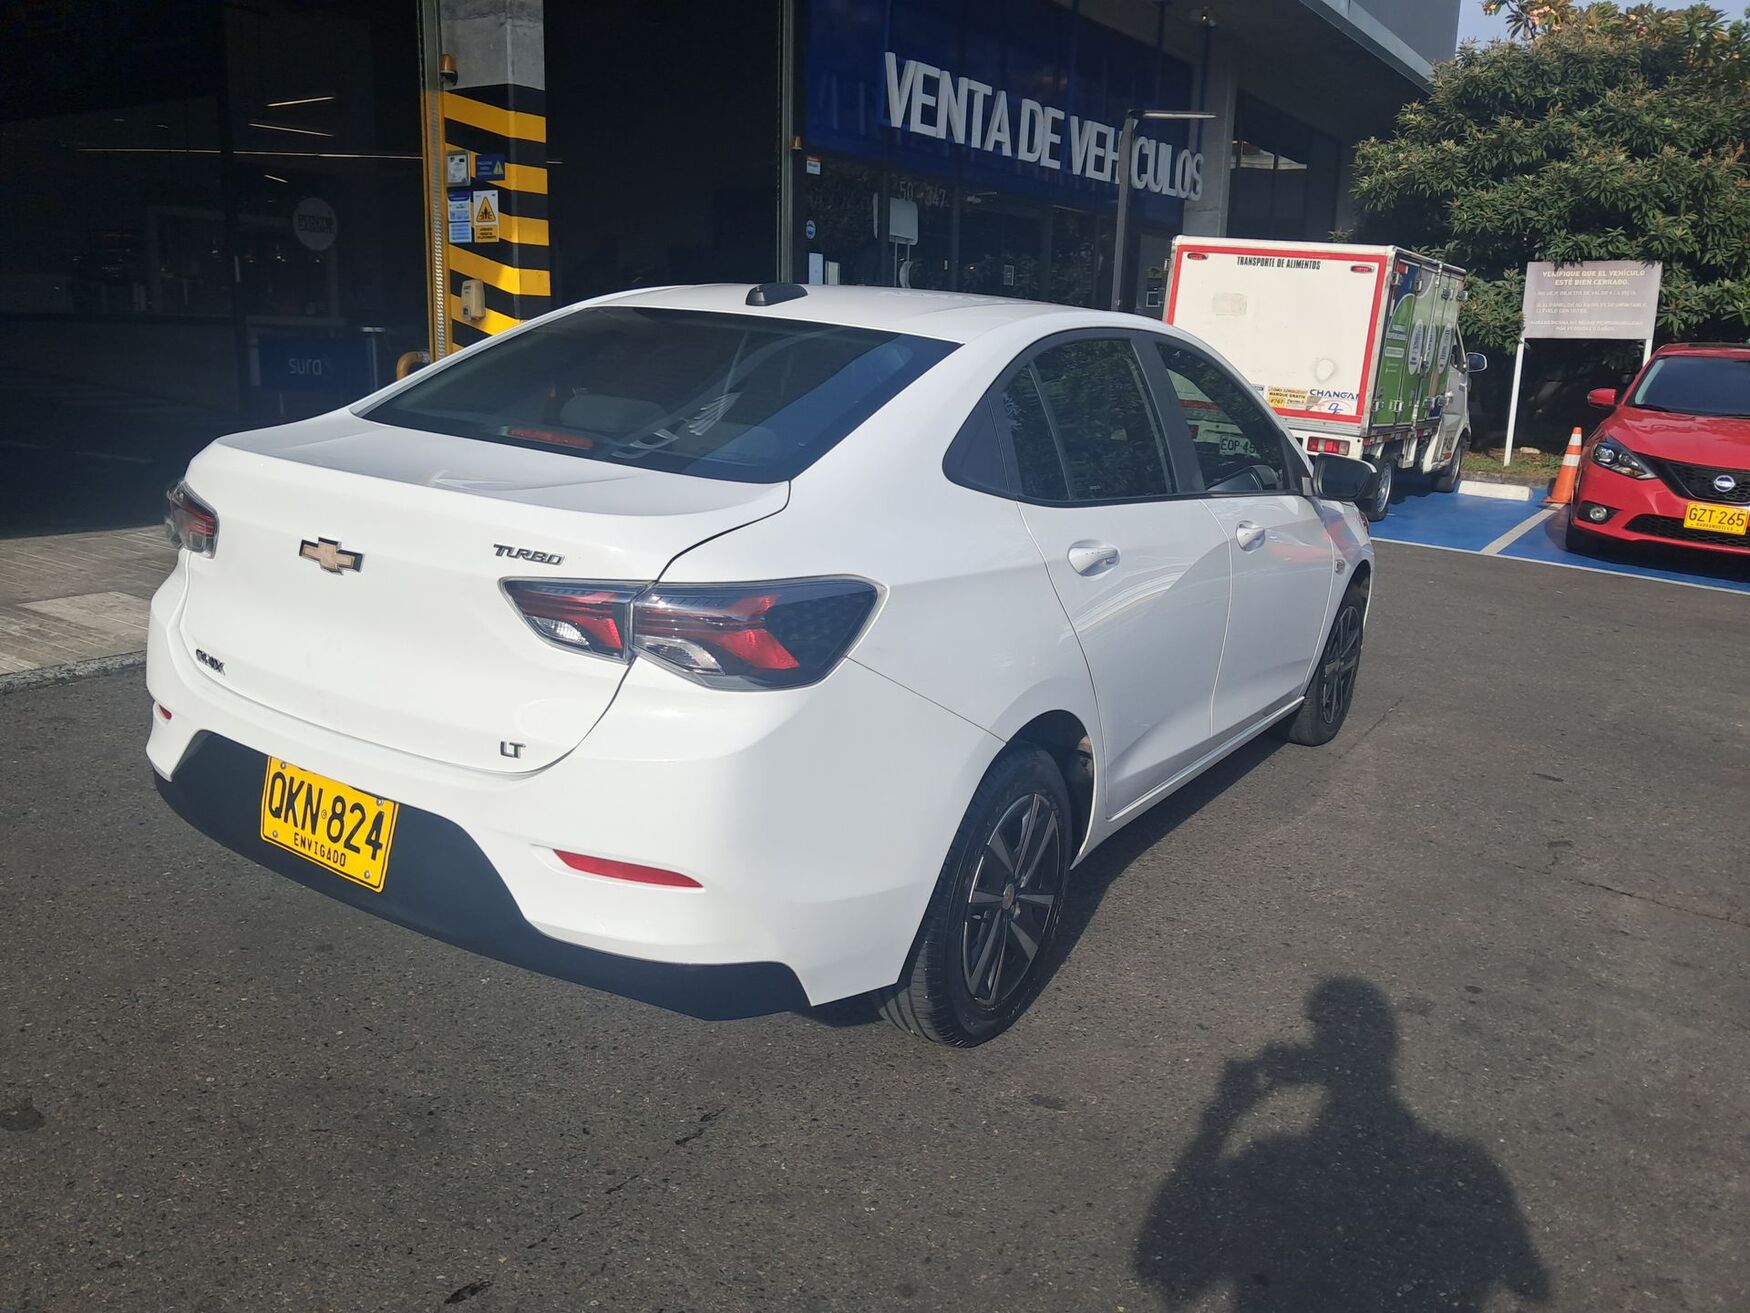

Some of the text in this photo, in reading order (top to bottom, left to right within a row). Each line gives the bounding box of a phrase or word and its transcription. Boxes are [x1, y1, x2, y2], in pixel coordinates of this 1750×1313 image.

[885, 52, 1204, 200] VENTA DE VEHCULOS
[1237, 256, 1321, 270] TRANSPORTE DE ALIMENTOS
[1542, 268, 1646, 278] VERIFIQUE QUE EL VEHÍCULO
[1555, 278, 1574, 286] ESTÉ
[1575, 278, 1592, 286] BIEN
[288, 358, 322, 376] sura
[1688, 507, 1716, 523] GZT
[1718, 511, 1746, 527] 265
[493, 543, 565, 566] TURBO
[500, 740, 527, 760] LT
[268, 771, 385, 861] QKN 824
[293, 832, 347, 867] ENVIGADO
